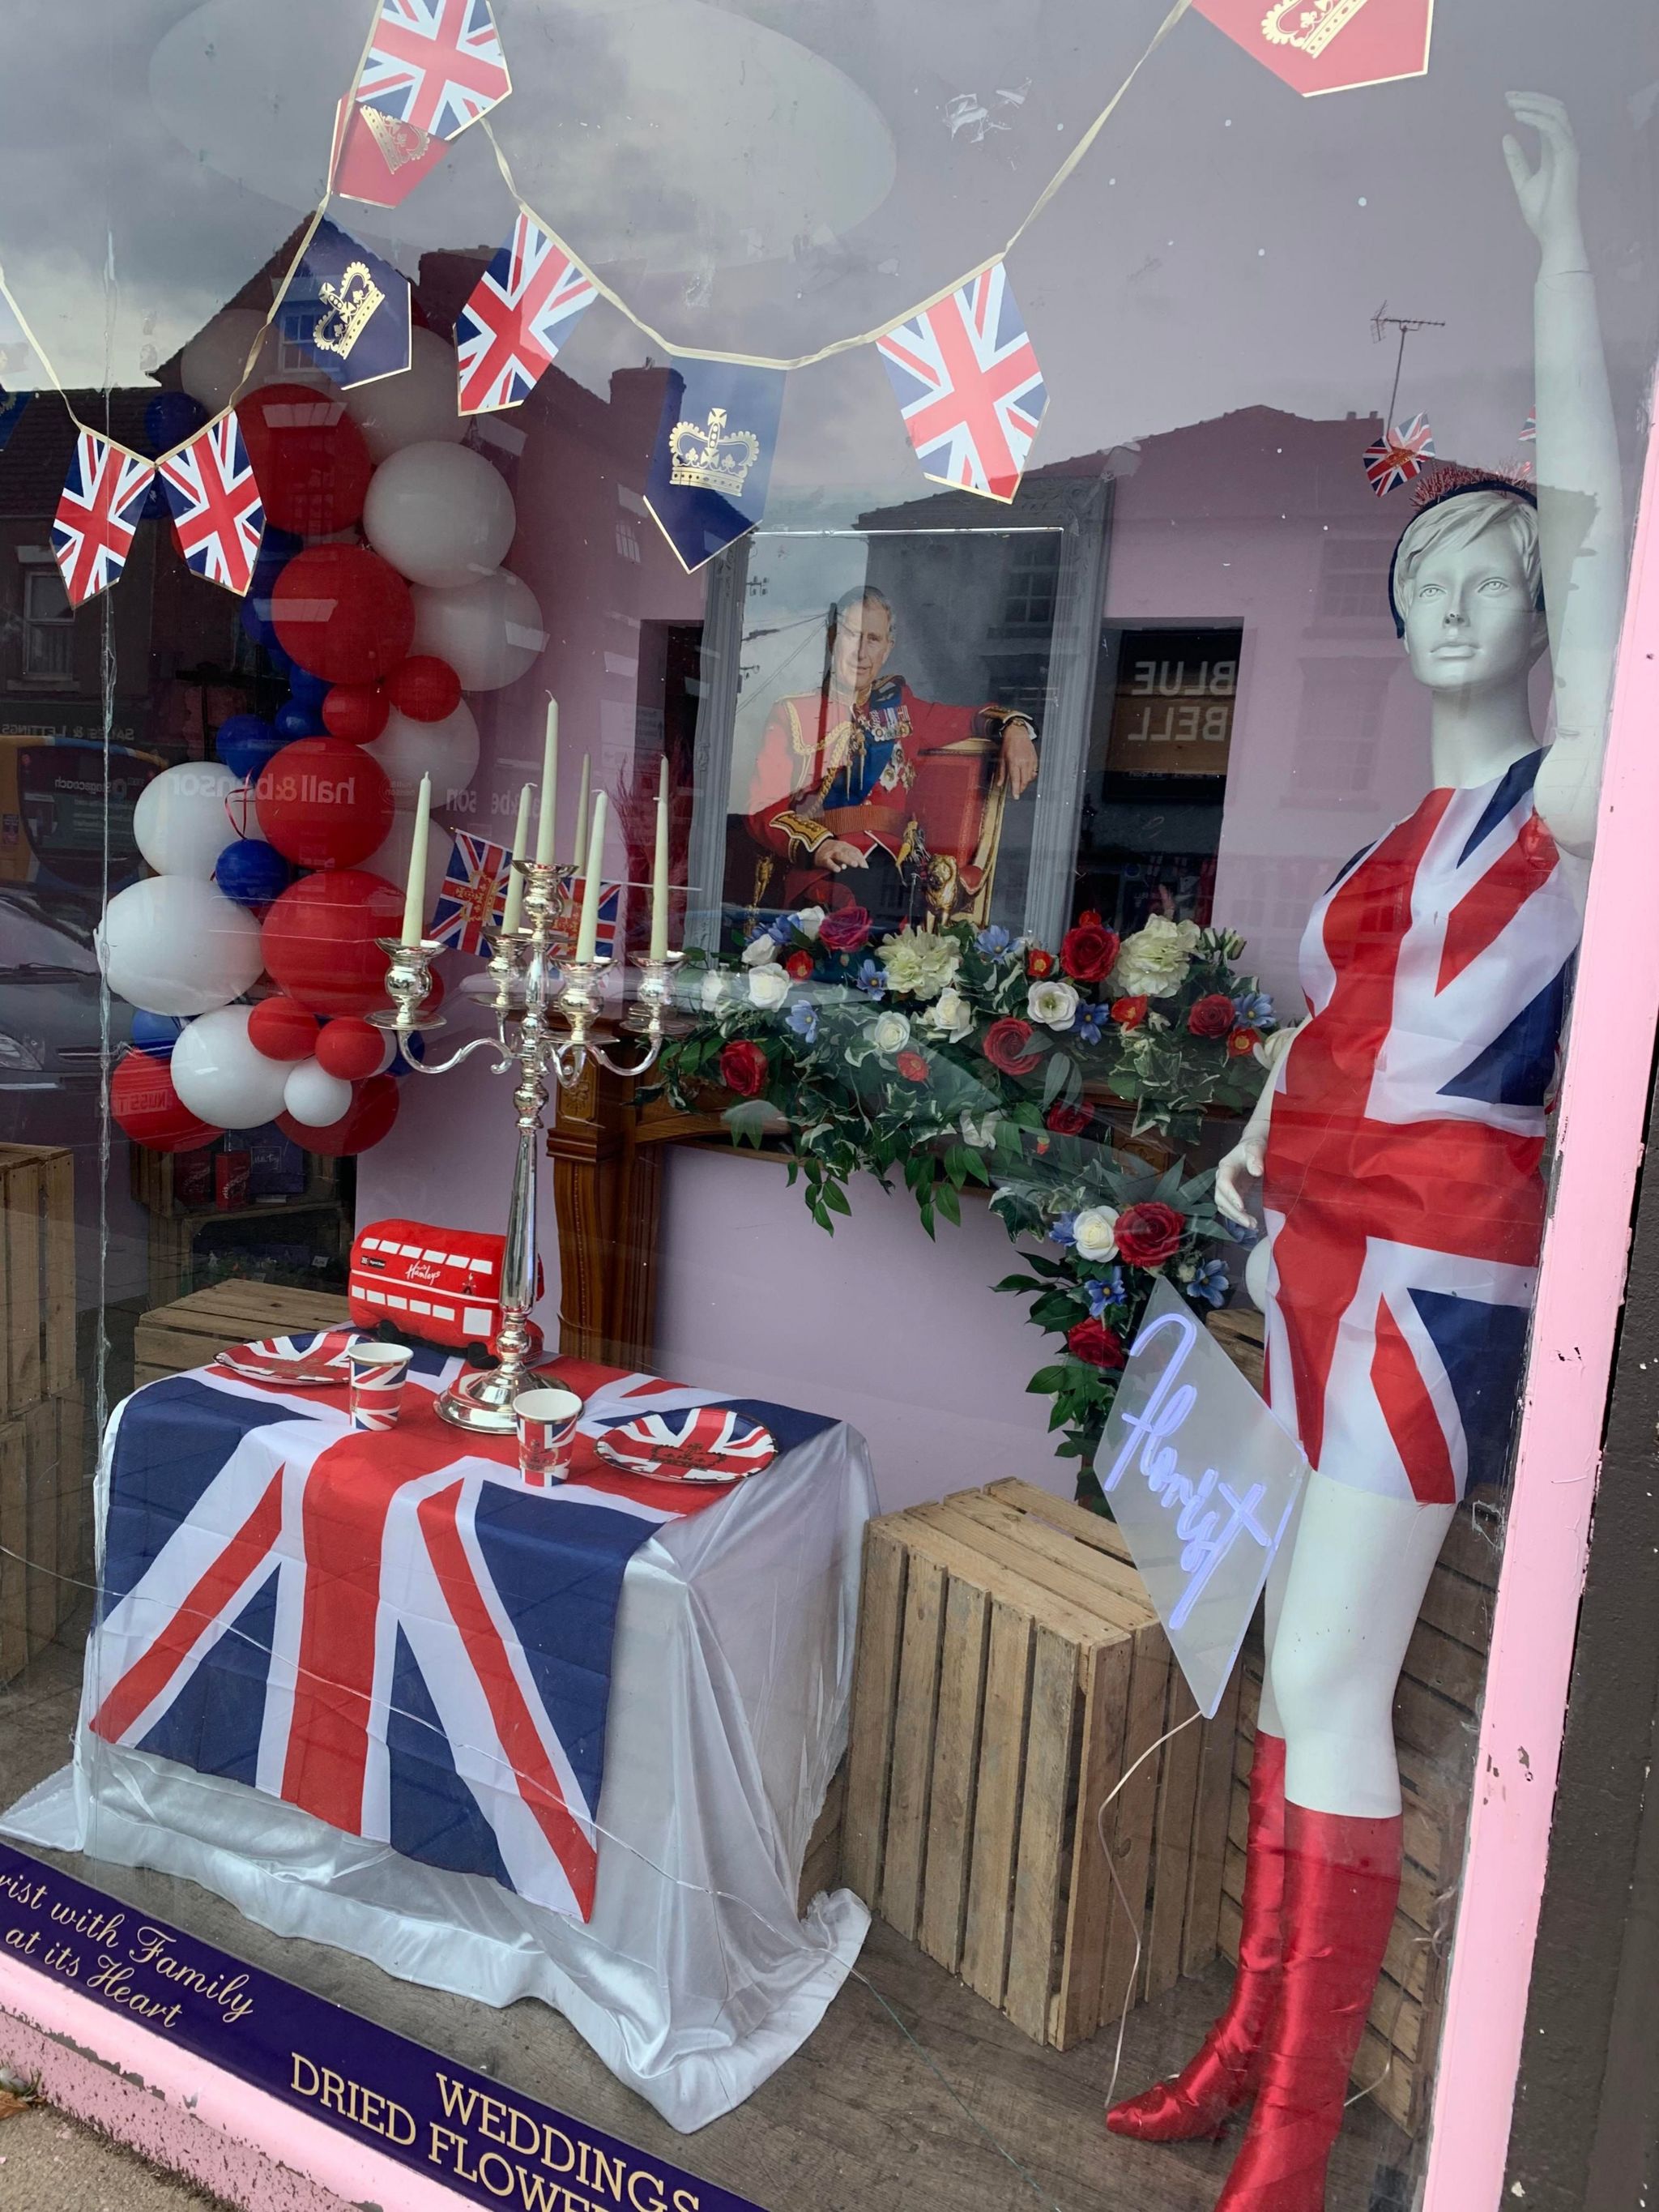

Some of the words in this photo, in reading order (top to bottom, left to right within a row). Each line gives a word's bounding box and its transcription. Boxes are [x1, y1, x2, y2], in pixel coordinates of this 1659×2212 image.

[405, 1260, 441, 1286] Hamleys
[6, 1928, 41, 1954] at
[44, 1941, 80, 1978] its
[86, 1954, 183, 2027] Heart
[50, 1901, 126, 1948] with
[129, 1925, 254, 2023] Family
[290, 2052, 416, 2146] DRIED
[427, 2122, 608, 2212] FLOWE
